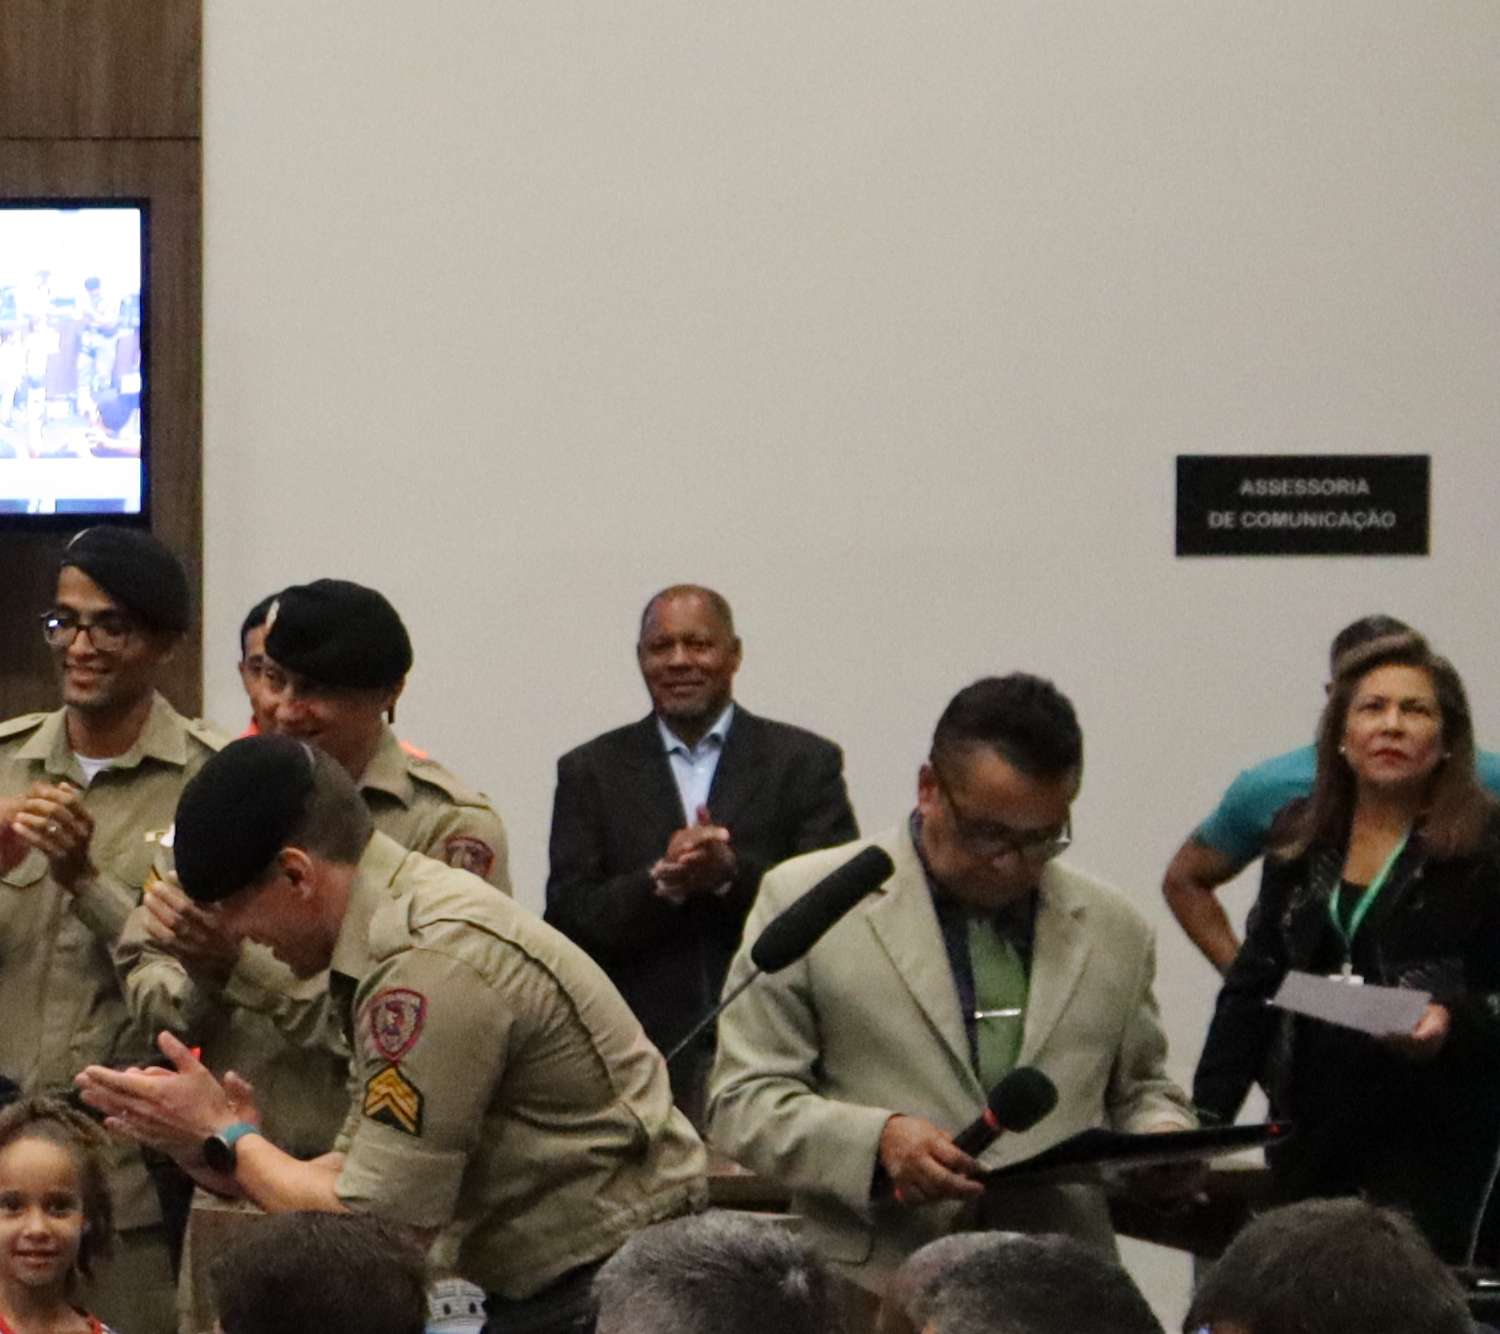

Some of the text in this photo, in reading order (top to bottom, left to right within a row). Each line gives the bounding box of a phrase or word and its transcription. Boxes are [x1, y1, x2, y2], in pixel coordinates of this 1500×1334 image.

[1239, 477, 1370, 496] ASSESSORIA
[1207, 508, 1397, 532] DE COMUNICAÇÃO
